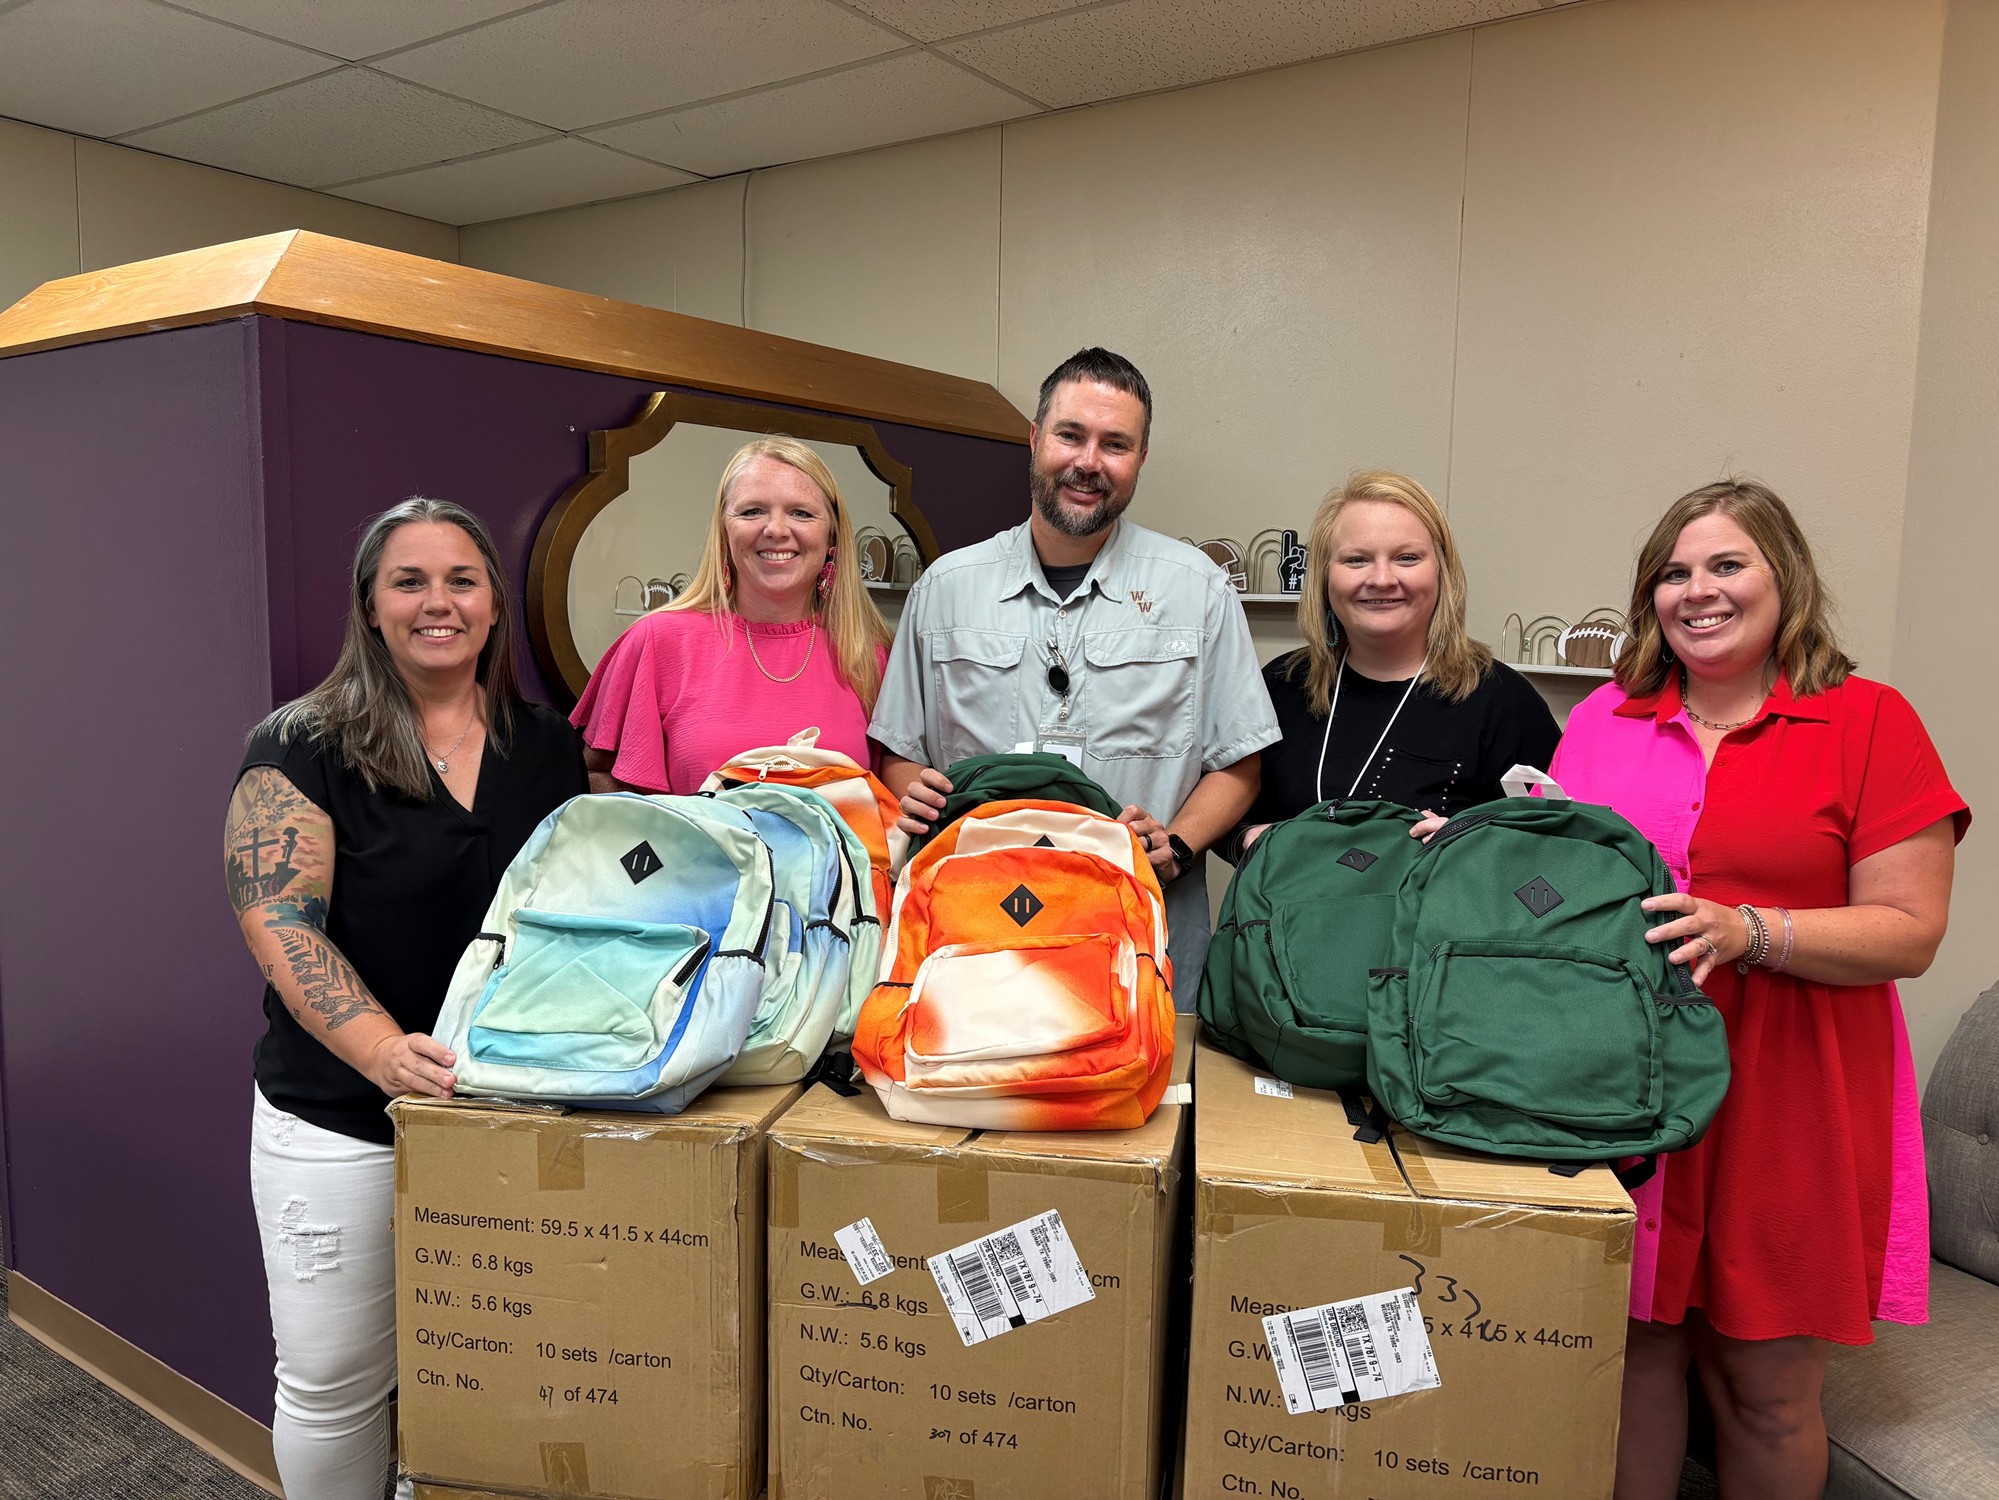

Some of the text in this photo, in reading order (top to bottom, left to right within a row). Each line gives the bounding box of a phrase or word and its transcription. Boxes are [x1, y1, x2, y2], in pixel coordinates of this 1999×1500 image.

[1130, 591, 1145, 601] W
[1137, 602, 1153, 613] W
[415, 1207, 708, 1247] Measurement: 59.5 x 41.5 x 44cm
[416, 1248, 533, 1277] G.W.: 6.8 kgs
[800, 1240, 930, 1271] Measent:
[981, 1240, 991, 1253] UPS
[987, 1252, 1002, 1277] GROUND
[1017, 1259, 1027, 1270] TX
[416, 1288, 532, 1318] N.W.: 5.6 kgs
[801, 1283, 927, 1316] G.W.: 68 kgs
[1325, 1307, 1334, 1321] UPS
[416, 1329, 671, 1368] Qty/Carton: 10 sets /carton
[801, 1324, 926, 1358] N.W.: 5.6 kgs
[1329, 1321, 1342, 1347] GROUND
[1360, 1333, 1371, 1344] TX
[1441, 1323, 1453, 1336] x
[1514, 1330, 1526, 1343] x
[1534, 1328, 1592, 1349] 44cm
[417, 1369, 449, 1386] Ctn.
[457, 1373, 483, 1390] No.
[564, 1387, 581, 1402] of
[586, 1388, 618, 1405] 474
[800, 1365, 1075, 1413] Qty/Carton: 10 sets /carton
[1227, 1385, 1280, 1408] N.W.:
[800, 1406, 835, 1425] Ctn.
[843, 1412, 871, 1430] No.
[960, 1430, 978, 1444] of
[983, 1432, 1017, 1449] 474
[1224, 1430, 1538, 1484] Qty/Carton: 10 sets /carton
[1222, 1474, 1262, 1495] Ctn.
